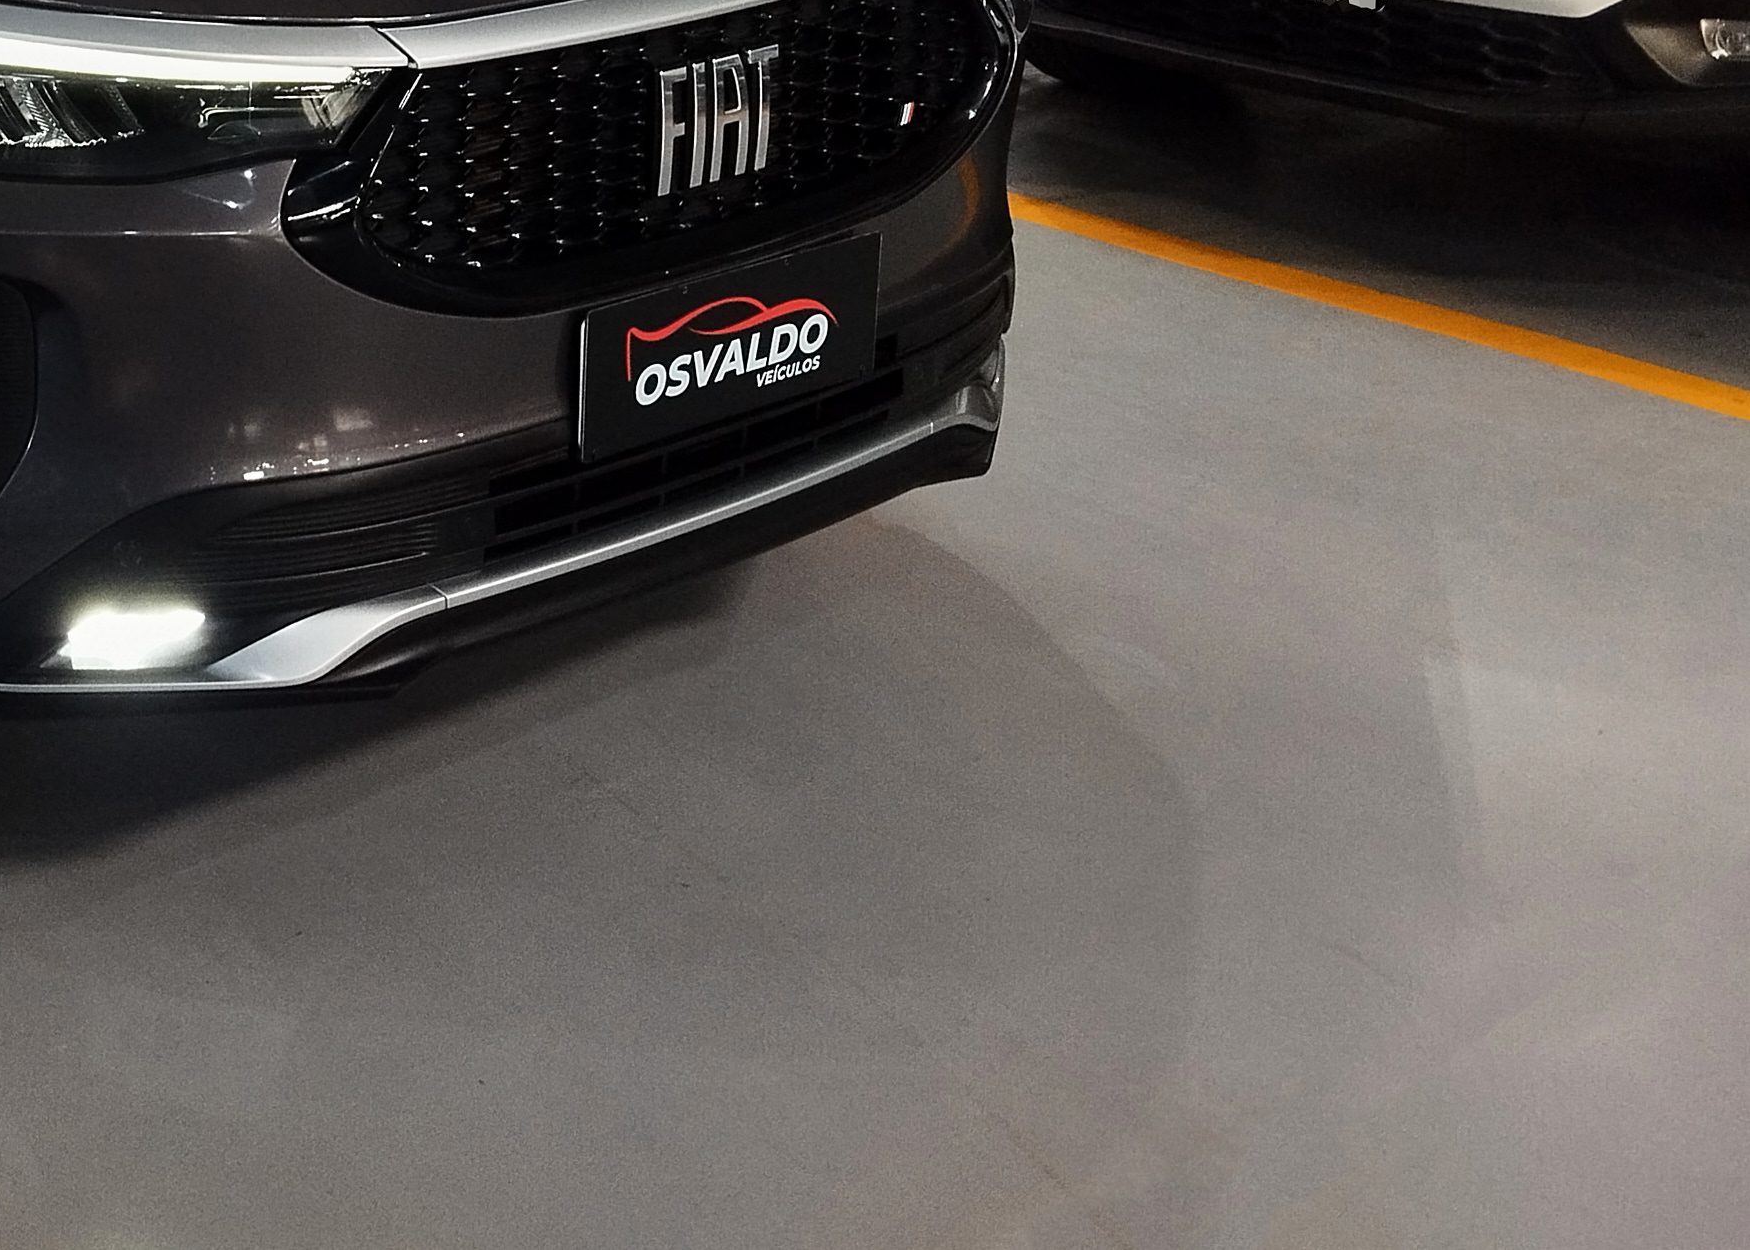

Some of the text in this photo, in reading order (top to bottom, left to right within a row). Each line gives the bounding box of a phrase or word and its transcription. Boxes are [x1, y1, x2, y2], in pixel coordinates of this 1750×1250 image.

[657, 44, 780, 197] FIAT
[635, 312, 830, 407] OSVALDO
[756, 355, 821, 388] VEÍCULOS
